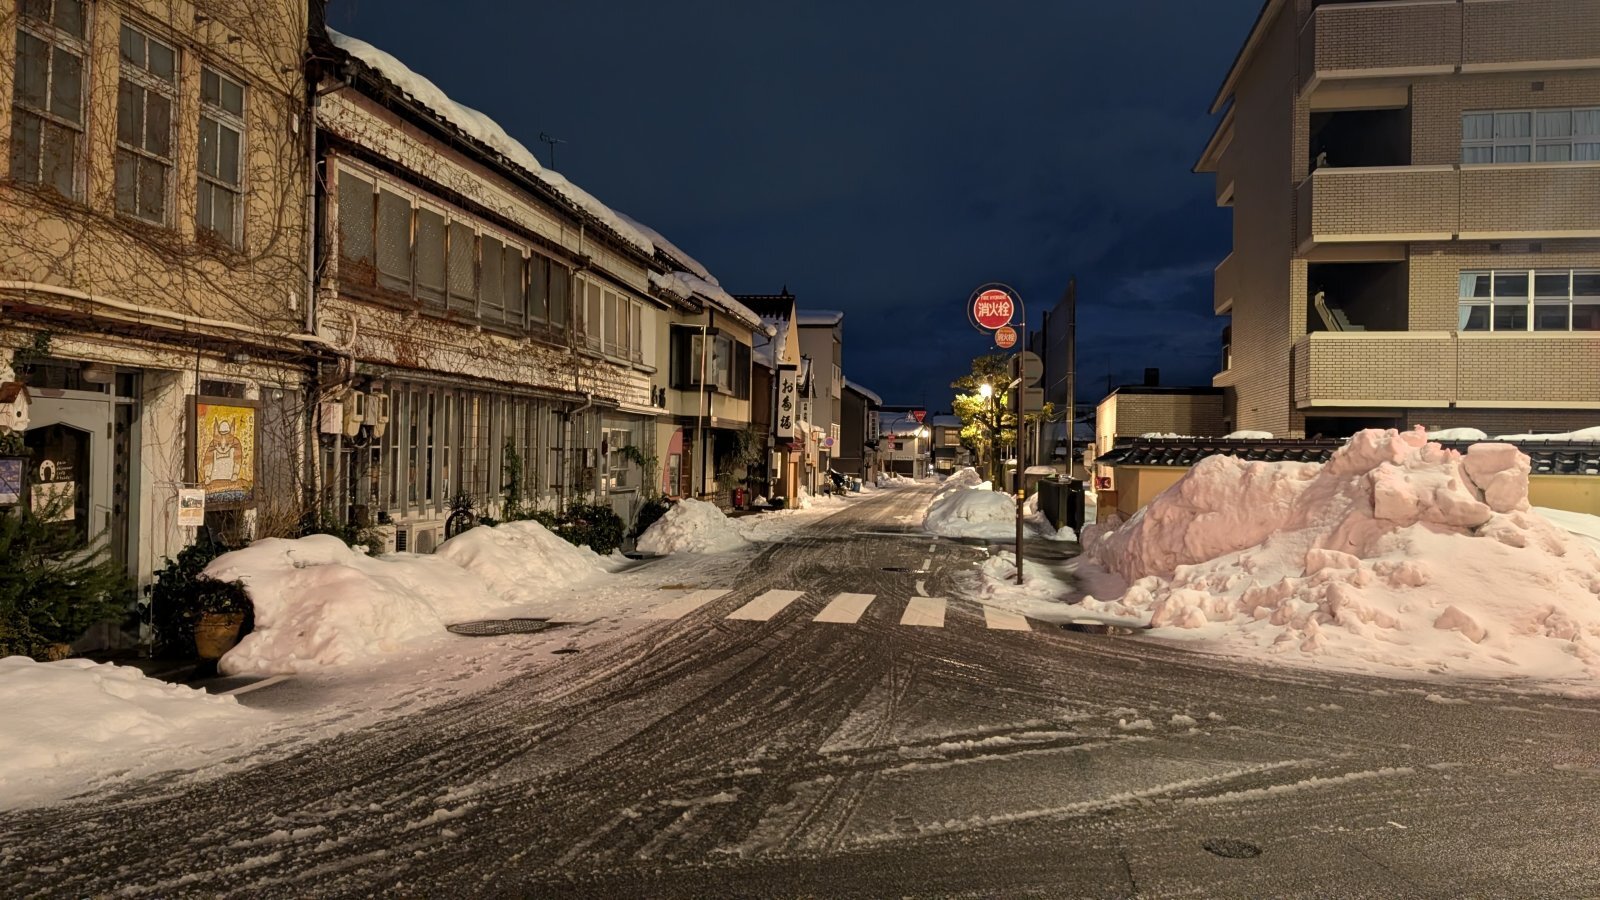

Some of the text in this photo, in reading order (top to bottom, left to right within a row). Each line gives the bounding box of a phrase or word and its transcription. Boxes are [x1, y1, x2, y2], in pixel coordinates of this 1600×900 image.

[978, 302, 1010, 317] 消火栓
[998, 333, 1015, 341] 消火栓
